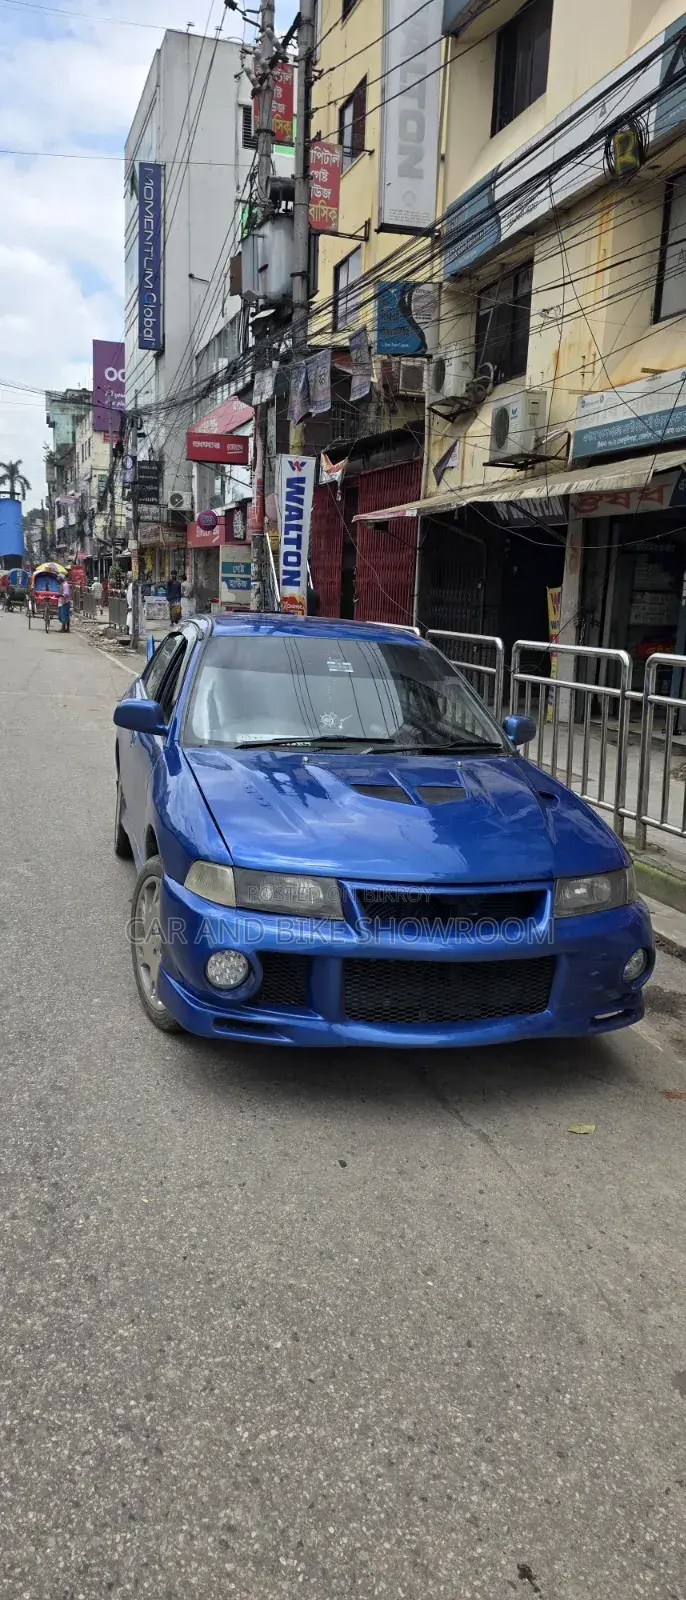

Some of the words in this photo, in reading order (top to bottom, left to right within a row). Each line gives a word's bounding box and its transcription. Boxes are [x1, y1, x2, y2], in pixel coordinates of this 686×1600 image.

[143, 167, 155, 289] MOMENTUM
[143, 292, 157, 342] Global
[282, 476, 307, 588] WALTON
